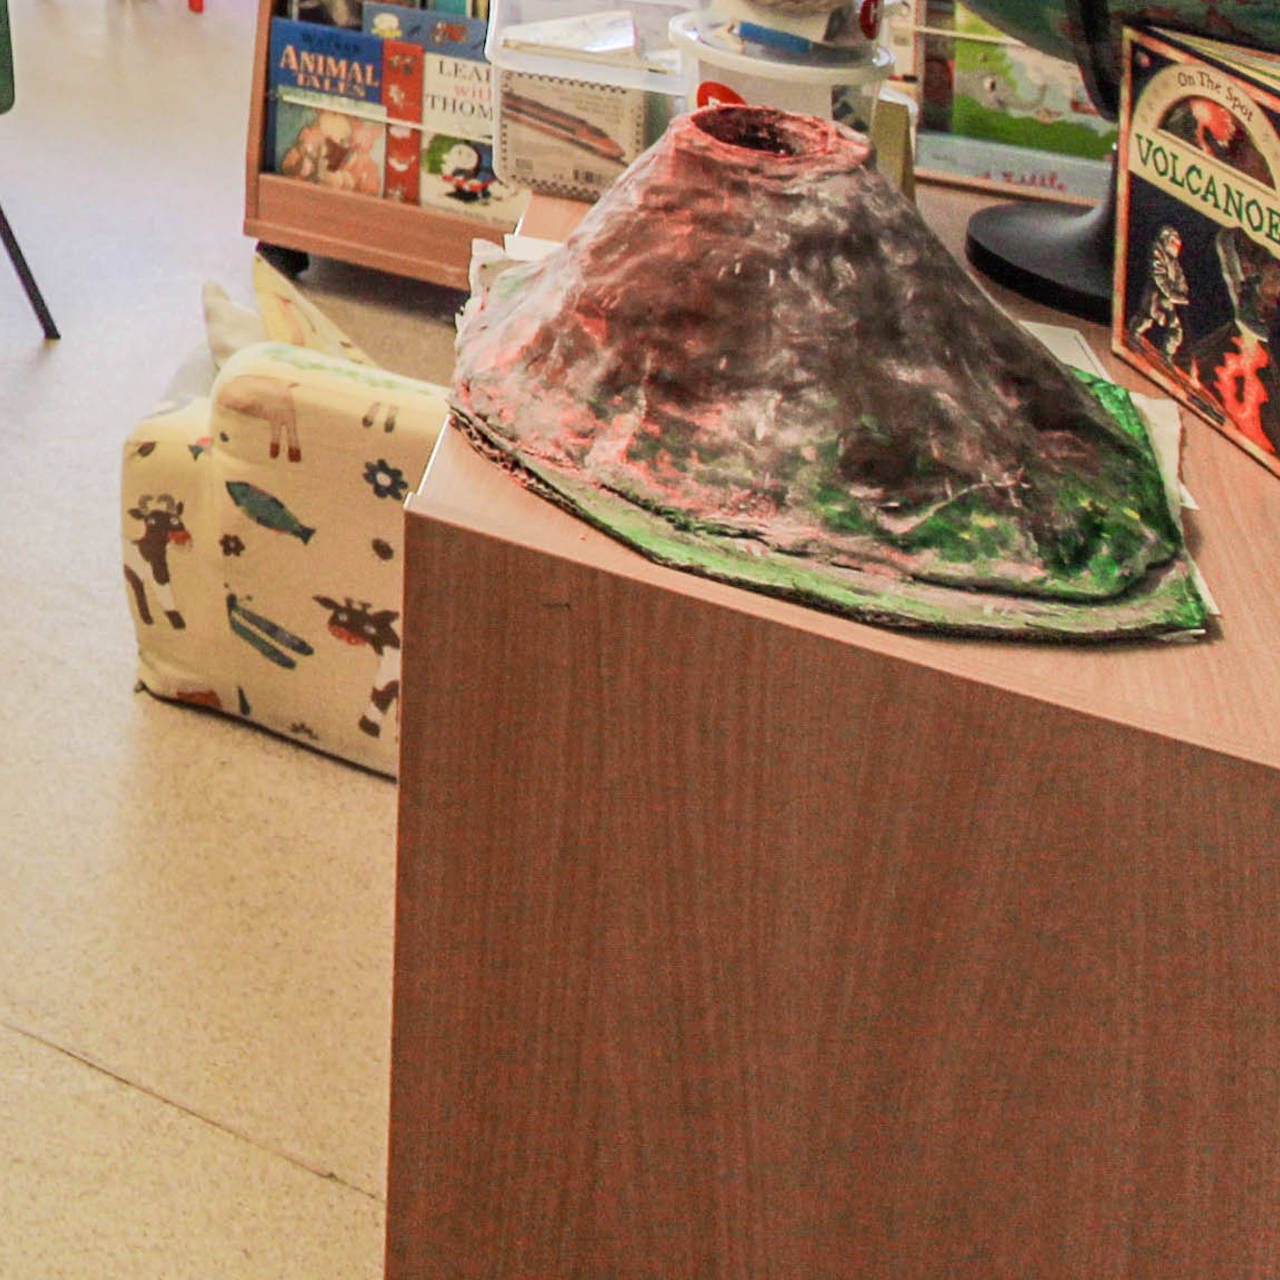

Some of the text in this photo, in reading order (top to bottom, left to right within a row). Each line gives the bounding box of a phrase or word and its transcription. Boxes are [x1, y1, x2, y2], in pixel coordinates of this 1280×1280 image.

[279, 44, 380, 88] ANIMAL
[1177, 71, 1254, 122] On The Spot
